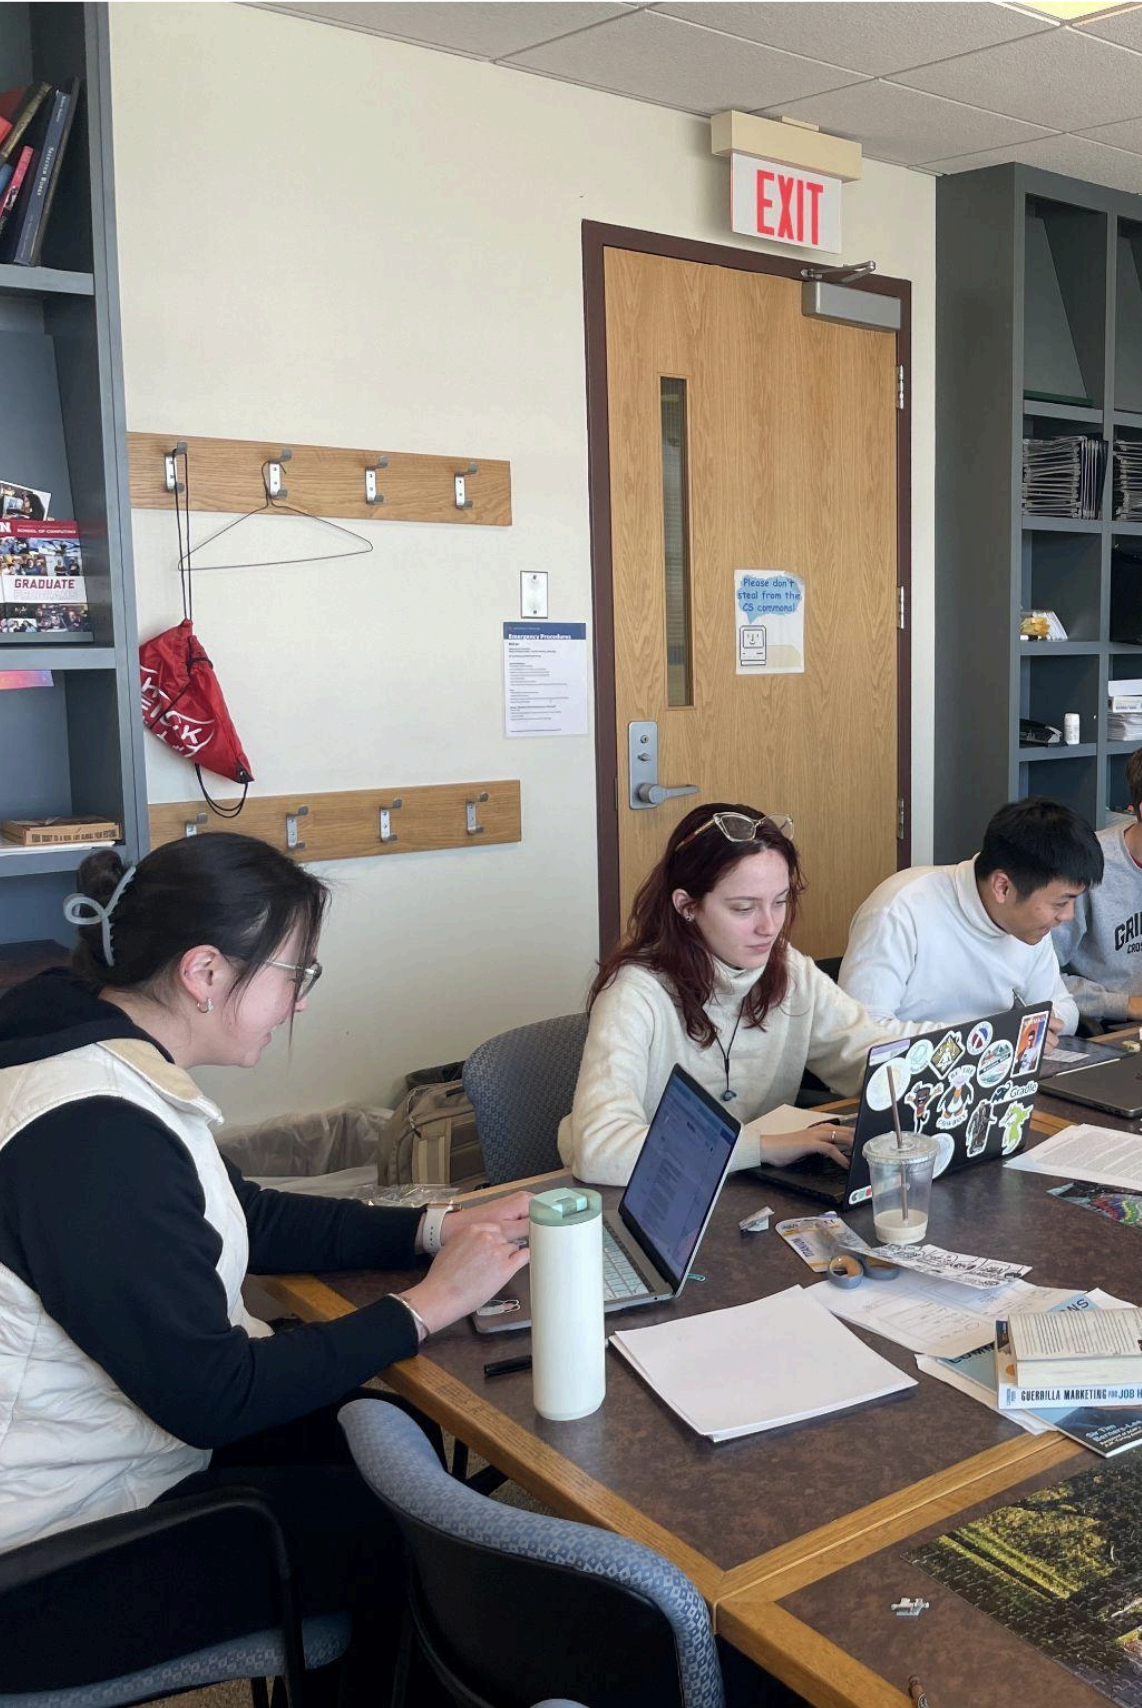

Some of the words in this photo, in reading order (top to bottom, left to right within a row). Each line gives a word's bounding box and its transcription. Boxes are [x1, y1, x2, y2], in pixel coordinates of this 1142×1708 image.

[756, 168, 825, 247] EXIT
[14, 578, 75, 589] GRADUATE
[743, 577, 770, 587] Please
[772, 578, 795, 588] don't
[737, 591, 759, 600] steal
[762, 591, 782, 600] from
[785, 591, 801, 600] the
[742, 602, 754, 612] CS
[757, 603, 796, 612] commons!
[1009, 1081, 1037, 1098] Gradle
[1020, 1389, 1061, 1401] GUERRILLA
[1063, 1388, 1107, 1401] MARKETING
[1119, 1388, 1135, 1399] JOB
